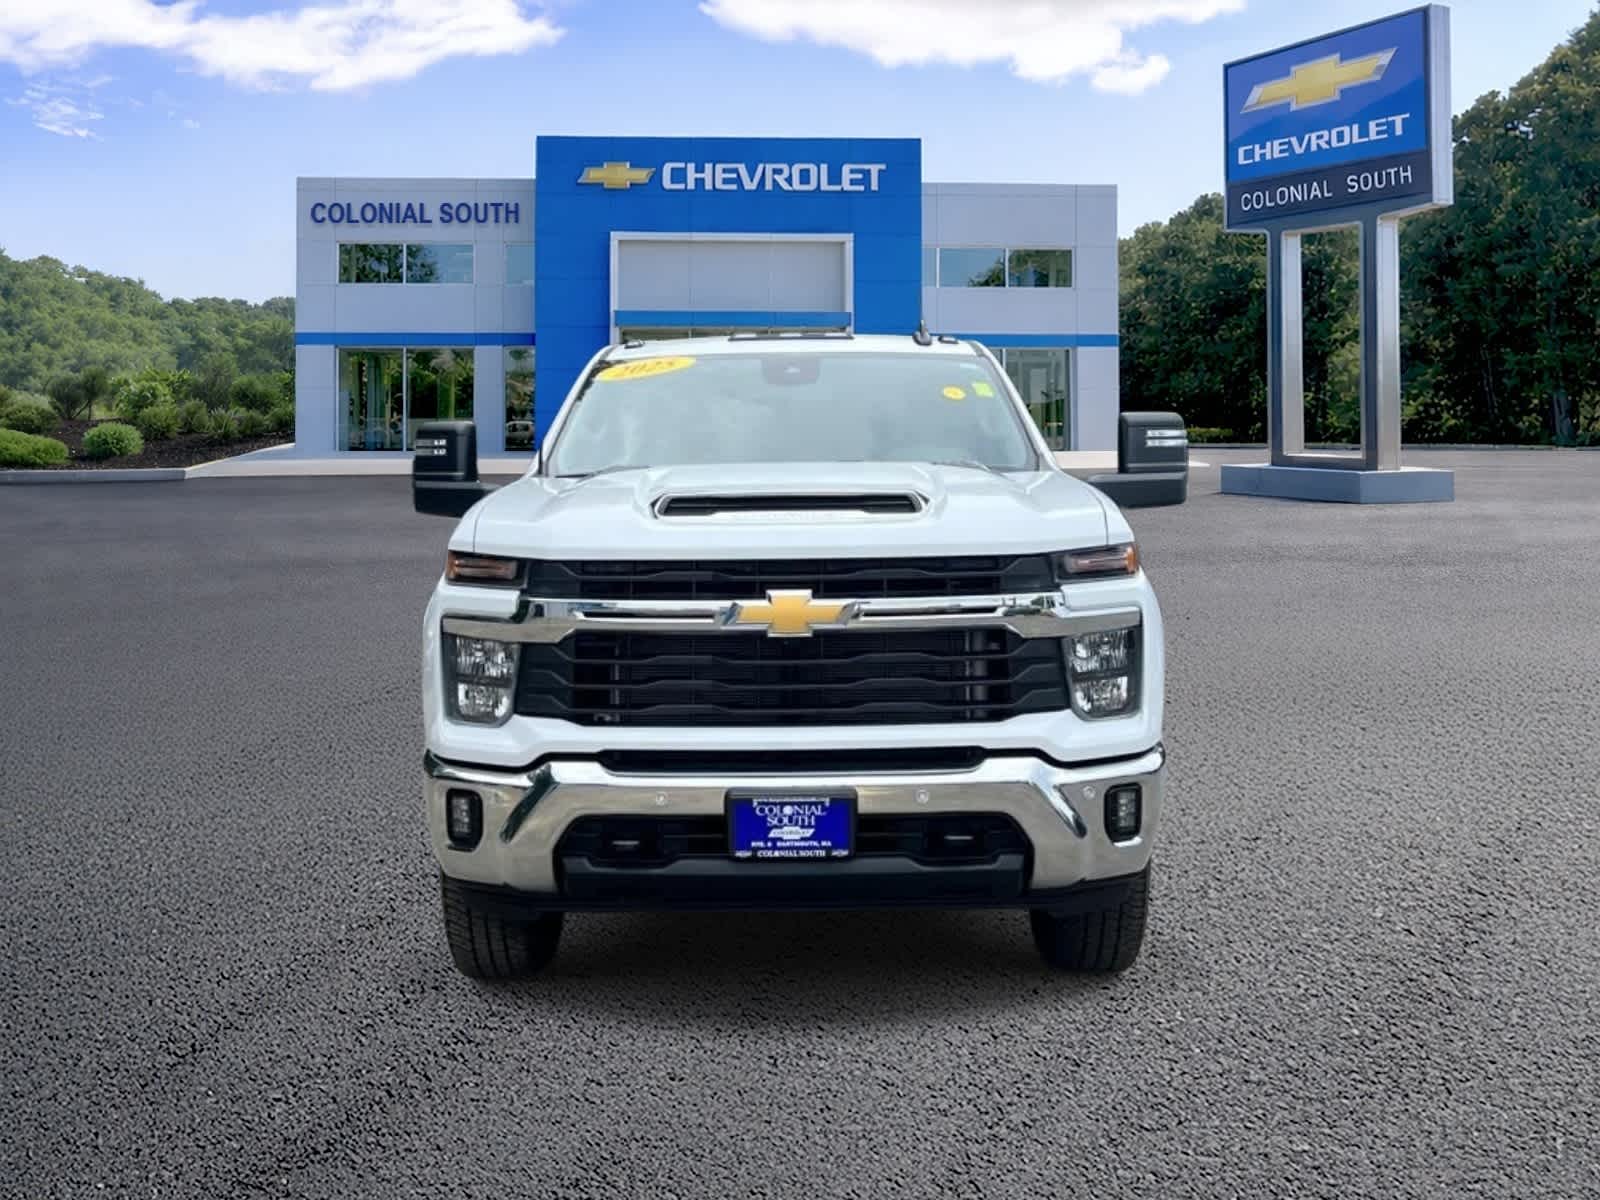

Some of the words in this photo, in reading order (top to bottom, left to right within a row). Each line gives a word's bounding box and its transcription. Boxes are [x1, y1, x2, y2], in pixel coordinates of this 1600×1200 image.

[1238, 113, 1410, 165] CHEVROLET
[662, 161, 887, 192] CHEVROLET
[1240, 179, 1333, 212] COLONIAL
[1346, 164, 1413, 194] SOUTH
[310, 202, 432, 224] COLONIAL
[439, 202, 520, 224] SOUTH
[755, 804, 827, 816] COLONIAL
[766, 815, 816, 827] SOUTH
[757, 849, 798, 858] COLONIAL
[799, 849, 826, 858] SOUTH
